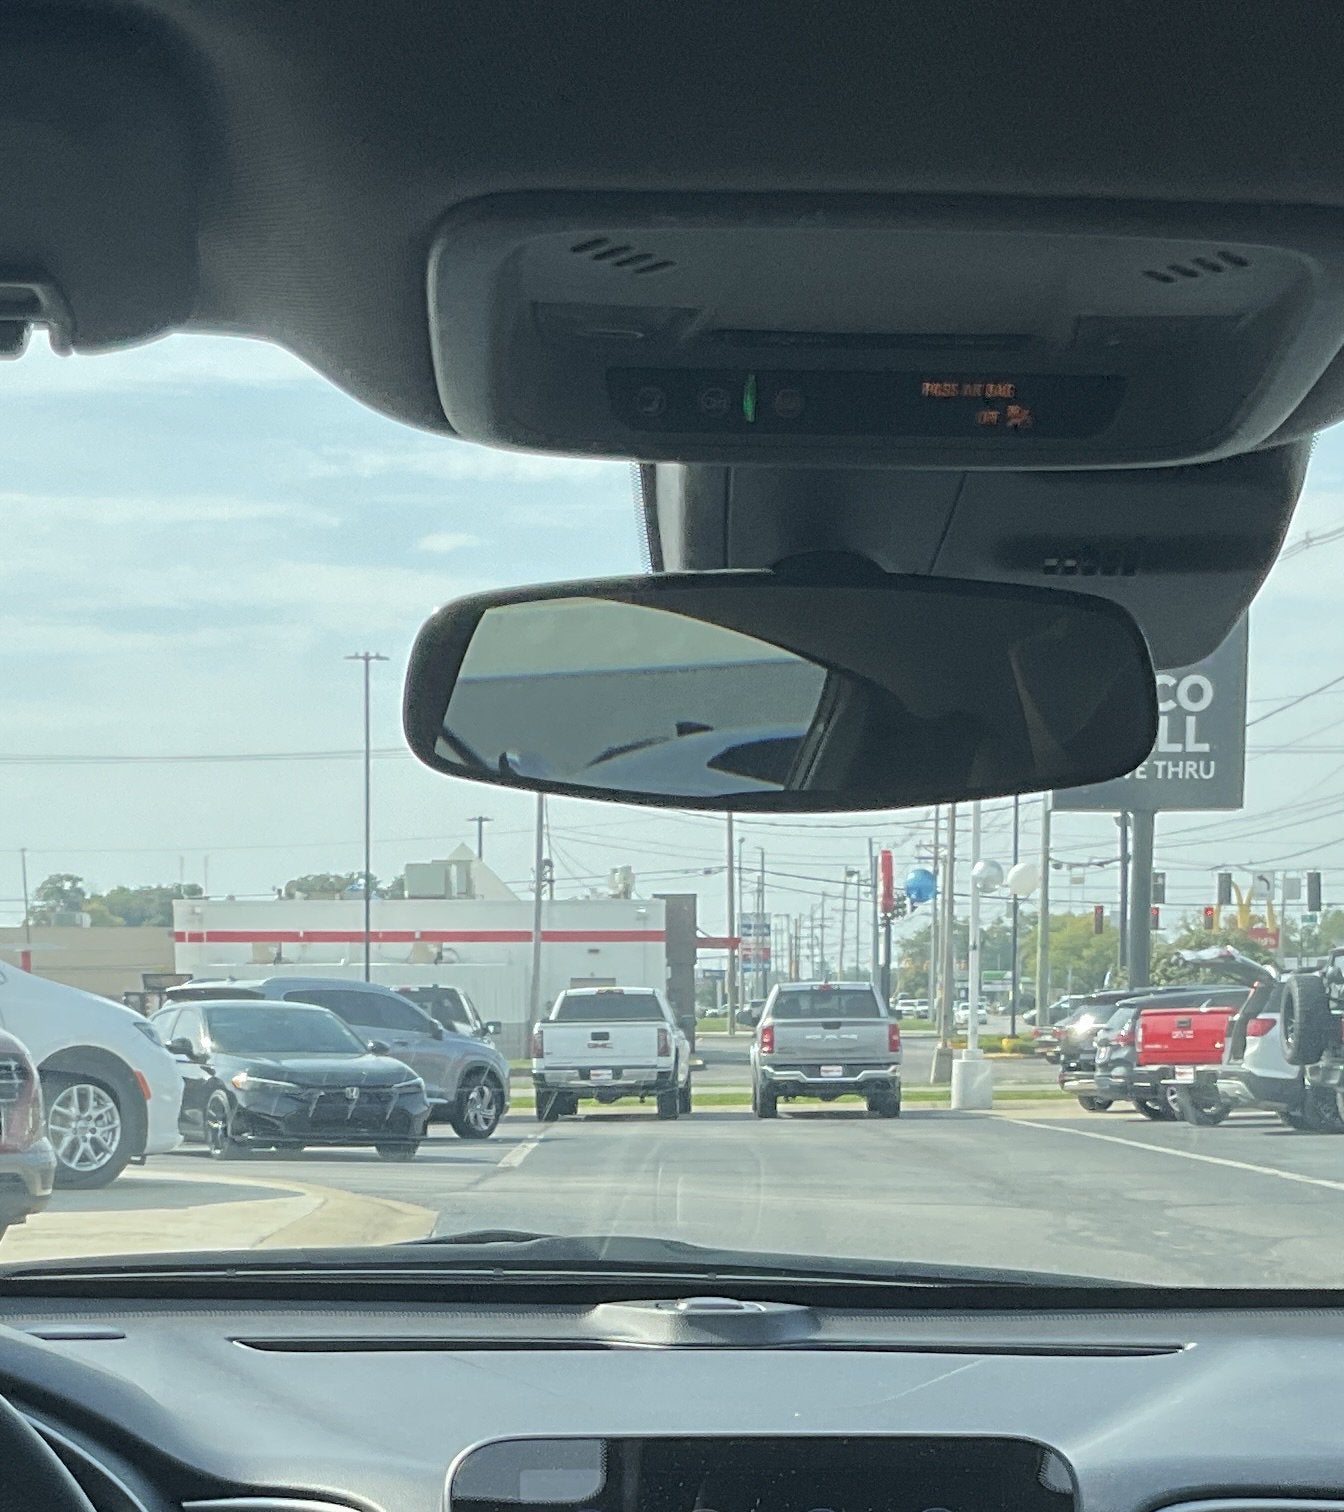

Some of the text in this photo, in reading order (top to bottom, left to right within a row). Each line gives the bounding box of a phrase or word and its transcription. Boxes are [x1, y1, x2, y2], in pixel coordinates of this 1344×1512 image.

[1156, 673, 1215, 713] CO
[1154, 715, 1211, 753] LL
[1153, 761, 1216, 780] THRU
